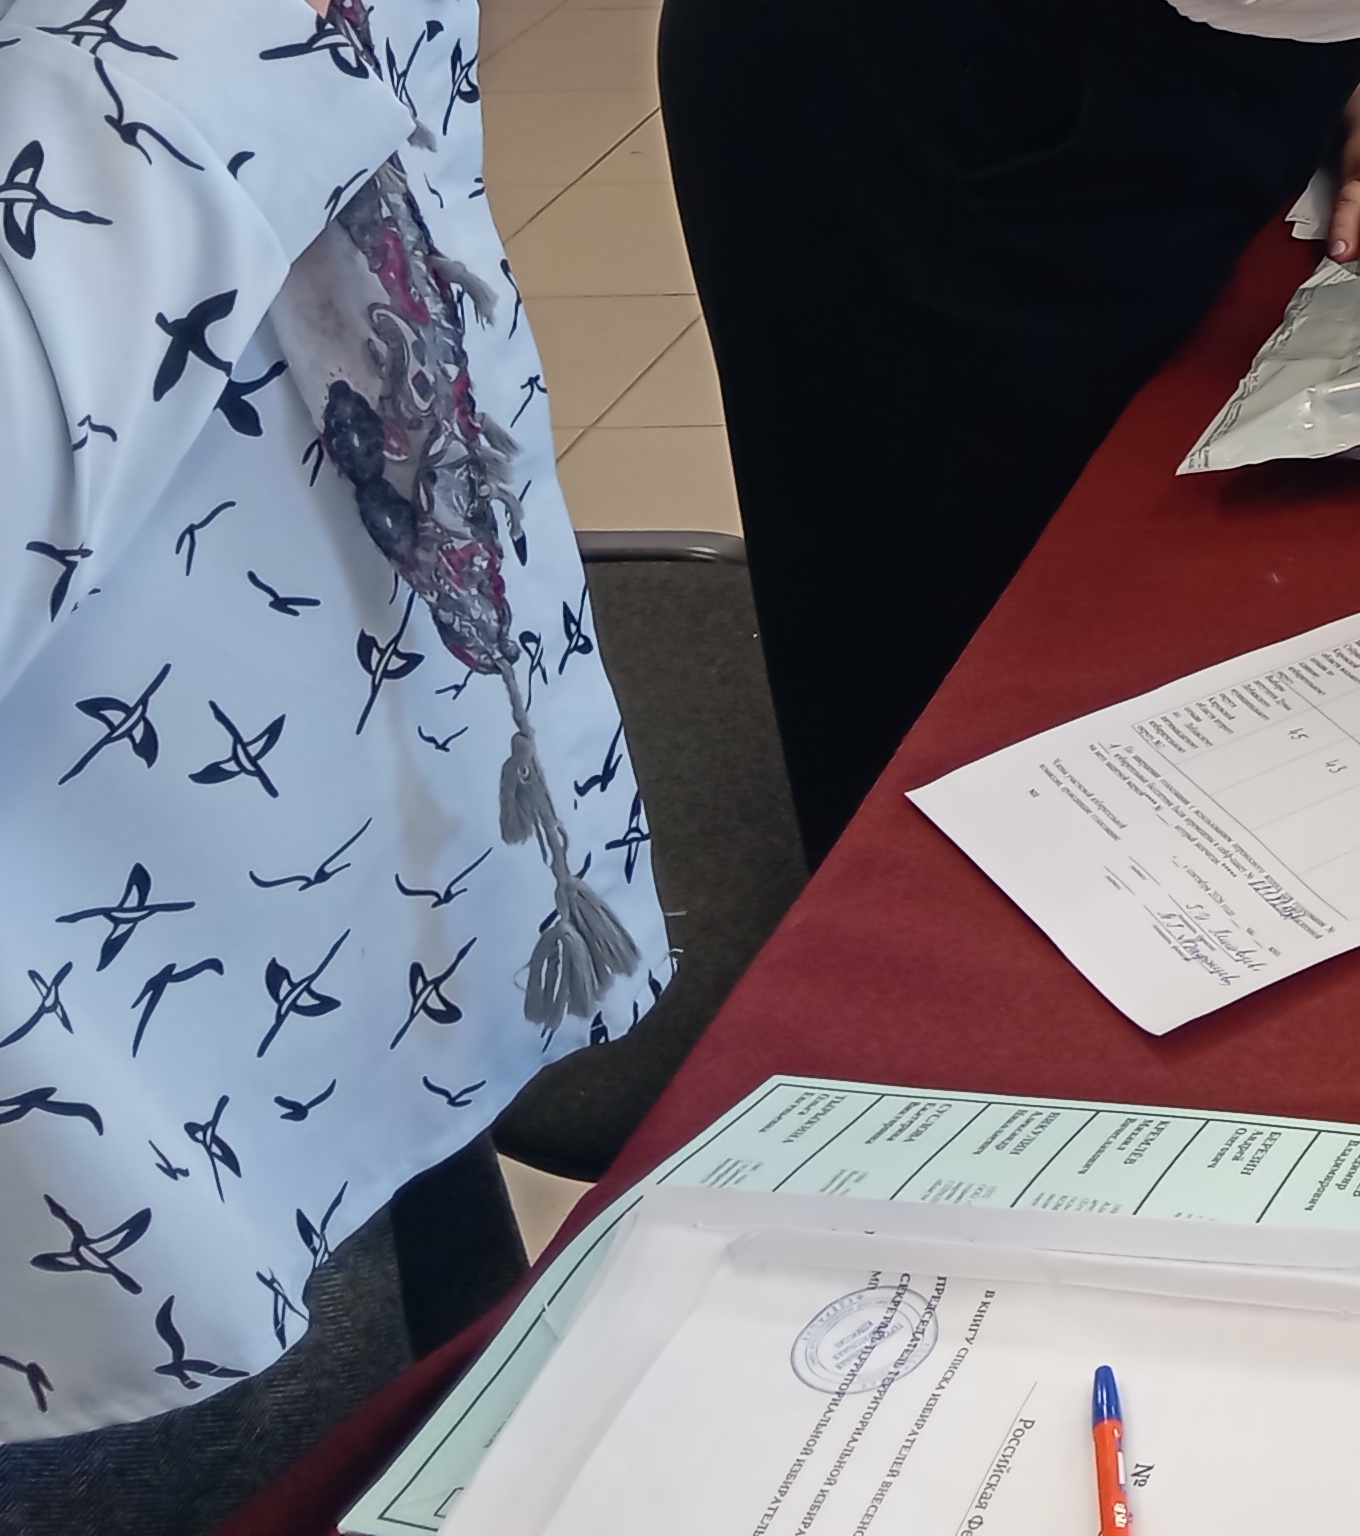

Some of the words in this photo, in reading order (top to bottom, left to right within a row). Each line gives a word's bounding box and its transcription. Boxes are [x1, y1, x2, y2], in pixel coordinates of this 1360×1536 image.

[993, 1109, 1044, 1151] Александр
[1008, 1110, 1062, 1156] НИКУЛИН
[1205, 1126, 1248, 1169] Олегович
[1230, 1129, 1264, 1162] Андрей
[1238, 1130, 1283, 1176] БЕРЕЗИН
[1302, 1138, 1360, 1212] Владимирович
[985, 1289, 996, 1298] В
[964, 1296, 992, 1346] КНИГУ
[935, 1346, 969, 1391] СПИСКА
[799, 1340, 876, 1455] ТЕРРИТОРИАЛЬНОЙ
[822, 1368, 900, 1486] ТЕРРИТОРИАЛЬНОЙ
[886, 1391, 943, 1478] ИЗБИРАТЕЛЕЙ
[973, 1417, 1036, 1510] Российская
[1129, 1462, 1155, 1488] №
